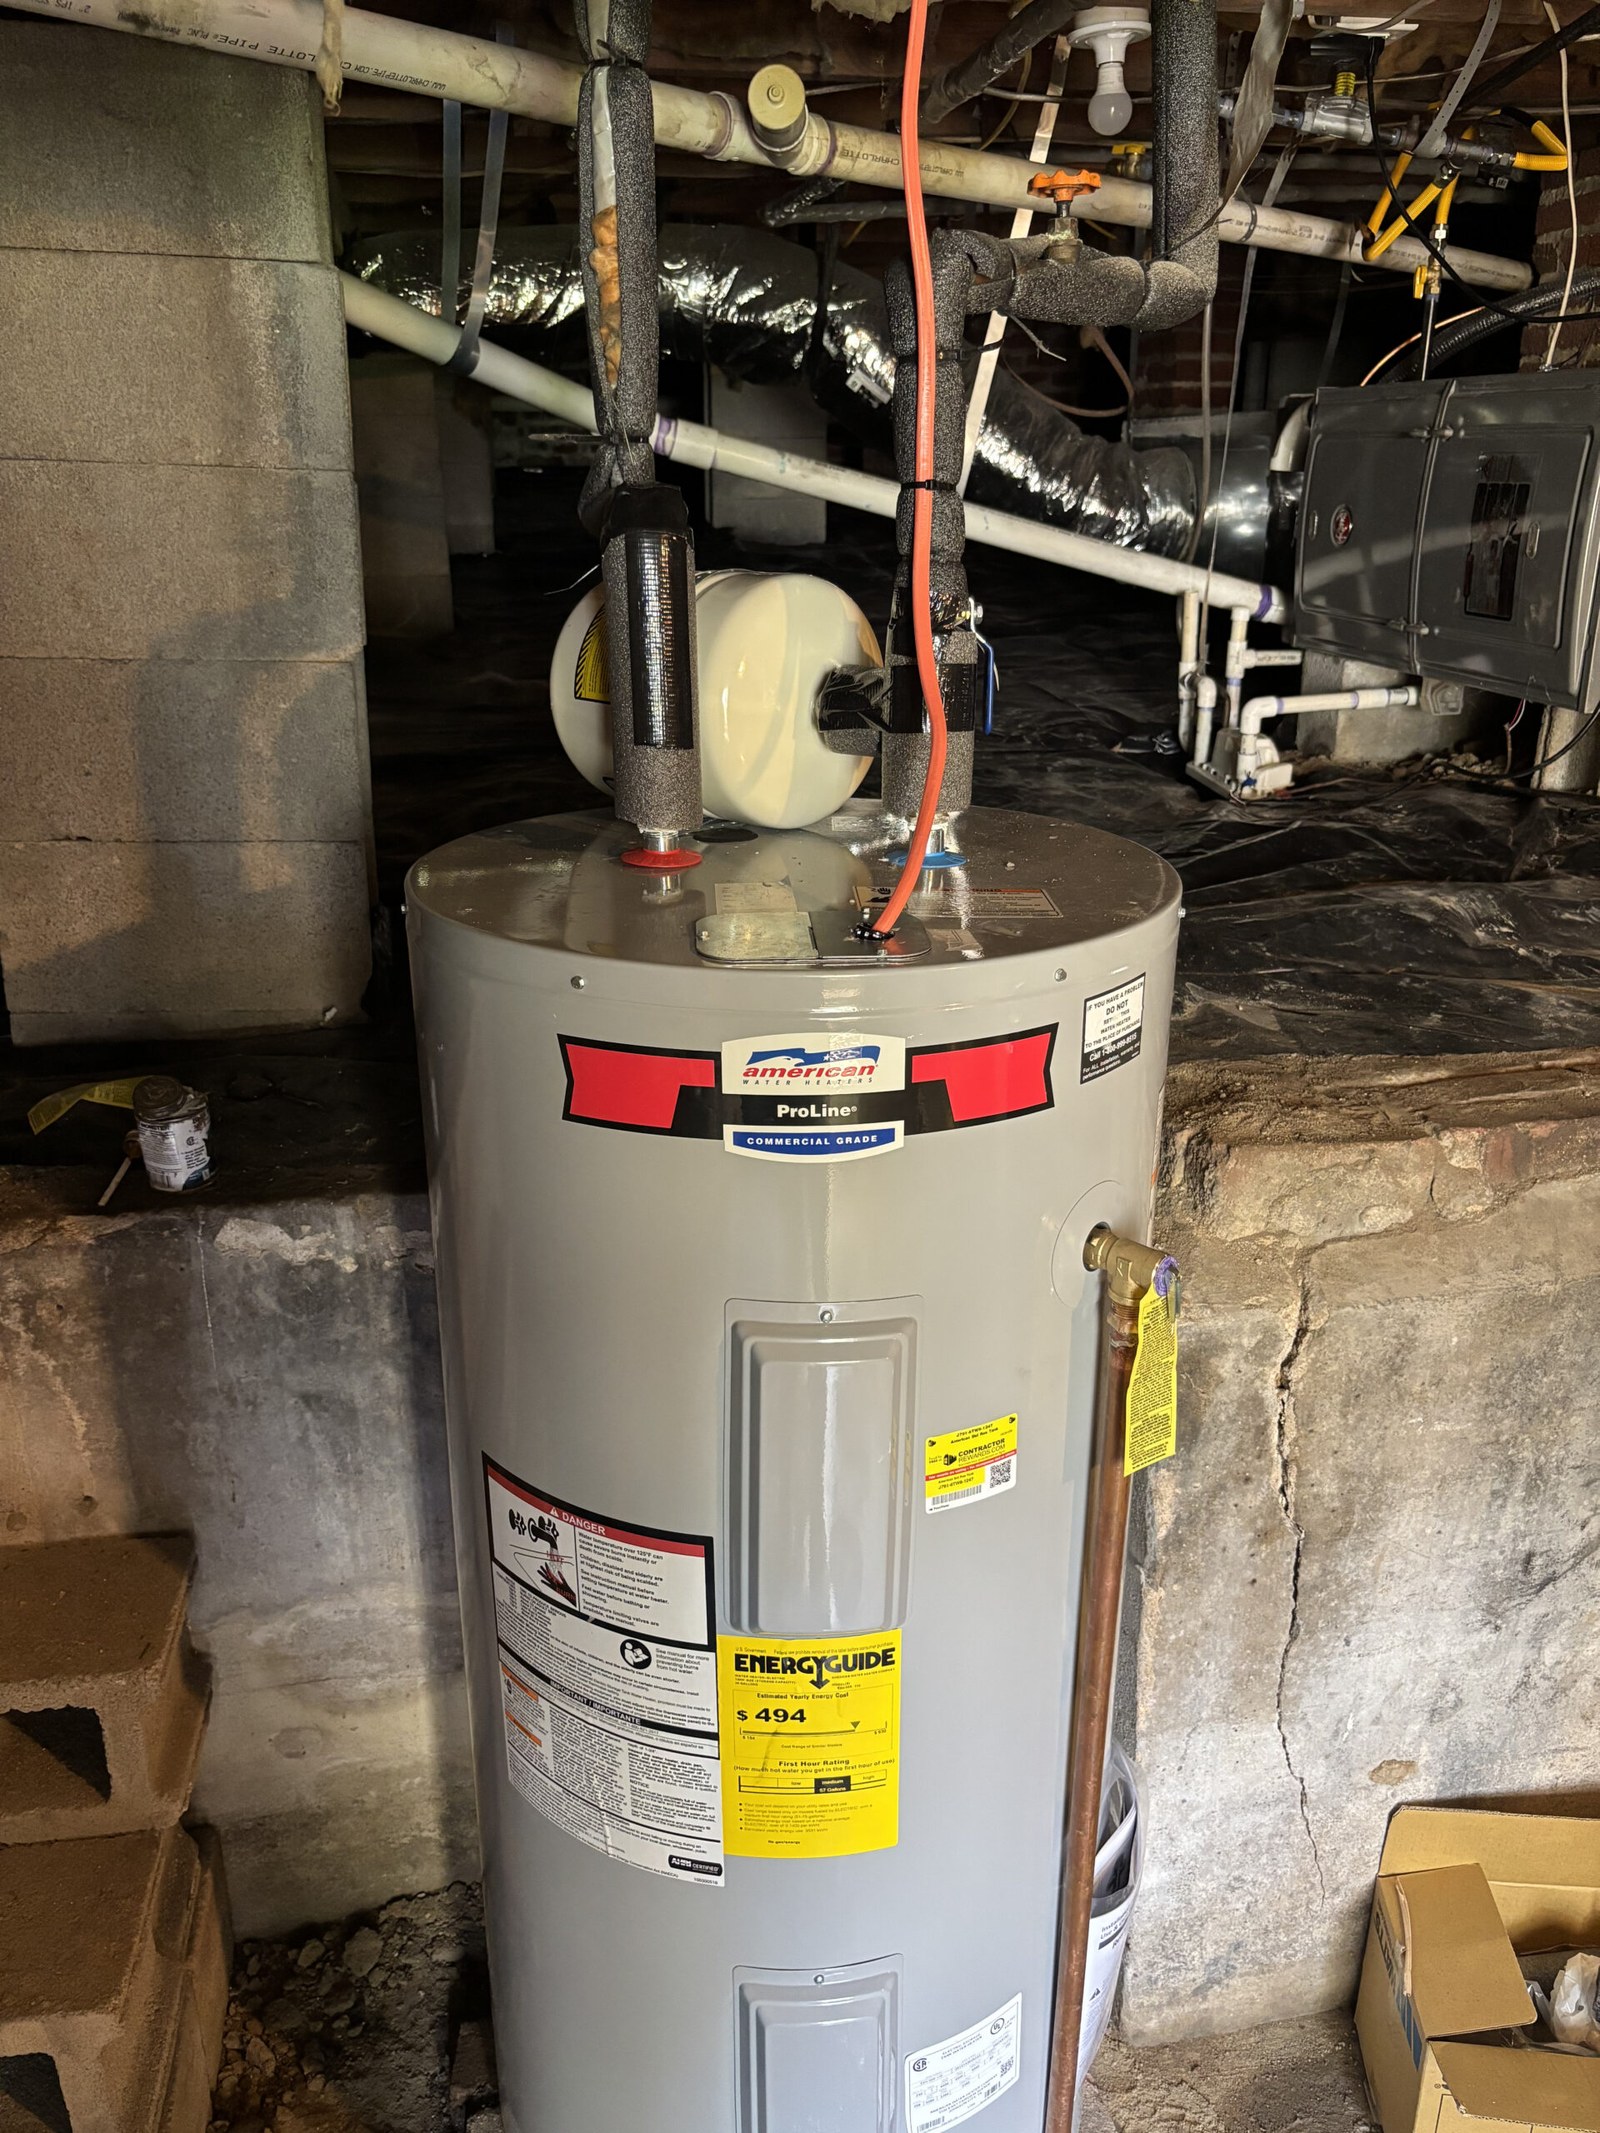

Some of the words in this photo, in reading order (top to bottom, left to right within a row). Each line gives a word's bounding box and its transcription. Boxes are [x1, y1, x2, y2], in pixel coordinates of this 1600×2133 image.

[1094, 998, 1106, 1010] YOU
[1106, 994, 1120, 1006] HAVE
[1106, 1005, 1116, 1016] DO
[1116, 999, 1129, 1012] NOT
[742, 1064, 876, 1078] american
[805, 1077, 873, 1086] HEATERS
[747, 1137, 830, 1146] COMMERCIAL
[836, 1134, 878, 1145] GRADE
[958, 1438, 1005, 1457] CONTRACTOR
[562, 1512, 606, 1536] DANGER
[735, 1647, 896, 1675] ENERGYGUIDE
[550, 1680, 588, 1704] IMPORTANT
[592, 1702, 641, 1724] IMPORTANTE
[811, 1692, 834, 1700] Energy
[736, 1710, 748, 1722] $
[755, 1708, 806, 1723] 494
[823, 1759, 850, 1767] Rating
[630, 1779, 650, 1789] NOTICE
